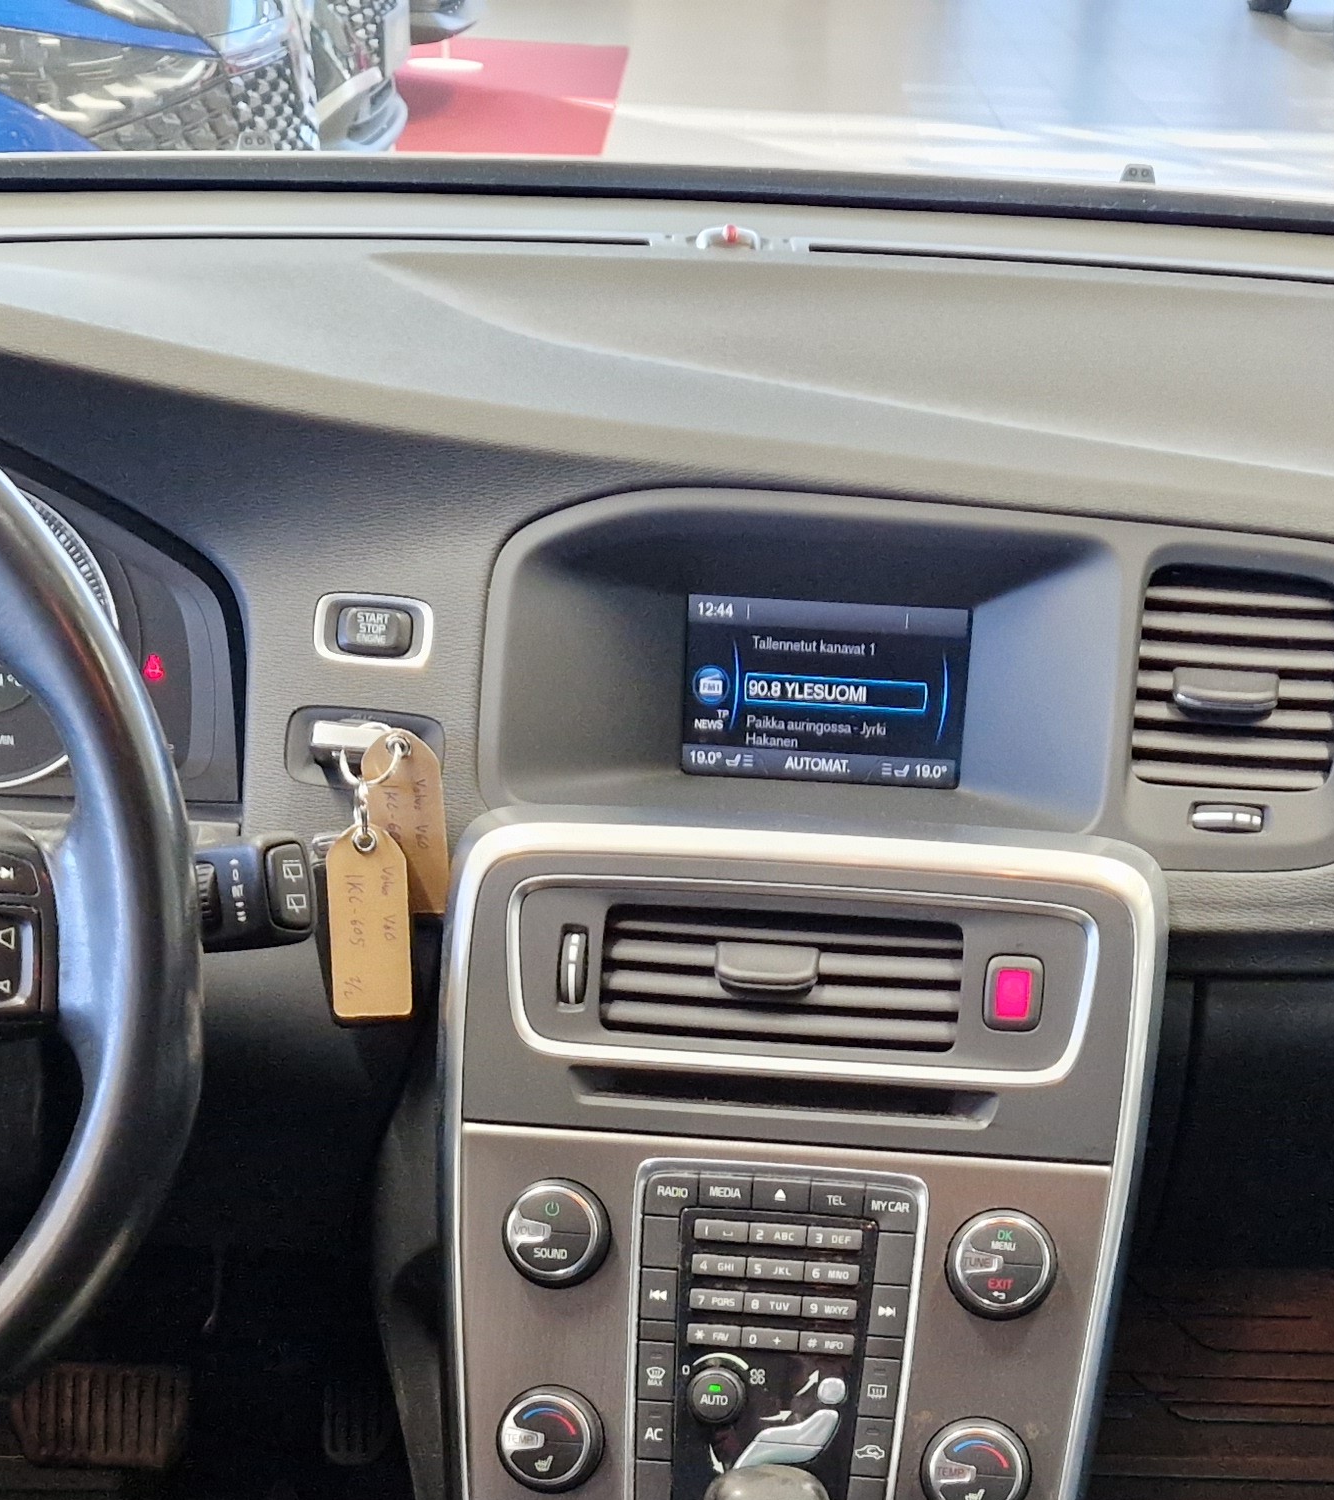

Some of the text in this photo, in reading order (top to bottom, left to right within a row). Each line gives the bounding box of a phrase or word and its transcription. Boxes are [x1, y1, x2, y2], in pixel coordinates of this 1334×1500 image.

[697, 602, 734, 618] 12:44
[356, 611, 390, 624] START
[359, 623, 386, 634] STOP
[356, 633, 387, 645] ENGINE
[752, 635, 876, 656] Tallennetut kanavat 1
[748, 679, 867, 703] 90.8 YLESUOMI
[717, 709, 729, 718] TP
[694, 718, 724, 730] NEWS
[747, 714, 785, 730] Paikka
[787, 718, 851, 735] auringossa
[859, 722, 887, 738] Jyrki
[745, 732, 799, 748] Hakanen
[784, 756, 851, 774] AUTOMAT.
[657, 1186, 689, 1199] RADIO
[709, 1186, 741, 1199] MEDIA
[827, 1194, 846, 1206] TEL
[756, 1230, 795, 1242] 2 ABC
[815, 1233, 852, 1245] 3 DEF
[997, 1230, 1013, 1240] OK
[991, 1240, 1017, 1252] MENU
[533, 1248, 568, 1260] SOUND
[699, 1260, 735, 1272] 4 GHI
[753, 1264, 792, 1276] 5 JKL
[812, 1268, 849, 1280] 6 MNO
[988, 1278, 1015, 1290] EXIT
[697, 1294, 705, 1305] 7
[751, 1299, 790, 1312] 8 TUV
[809, 1303, 849, 1316] 9 WXYZ
[712, 1331, 729, 1342] FAV
[749, 1334, 757, 1345] 0
[824, 1340, 844, 1350] INFO
[700, 1394, 728, 1406] AUTO
[644, 1428, 663, 1441] AC
[937, 1466, 965, 1478] TEMP
